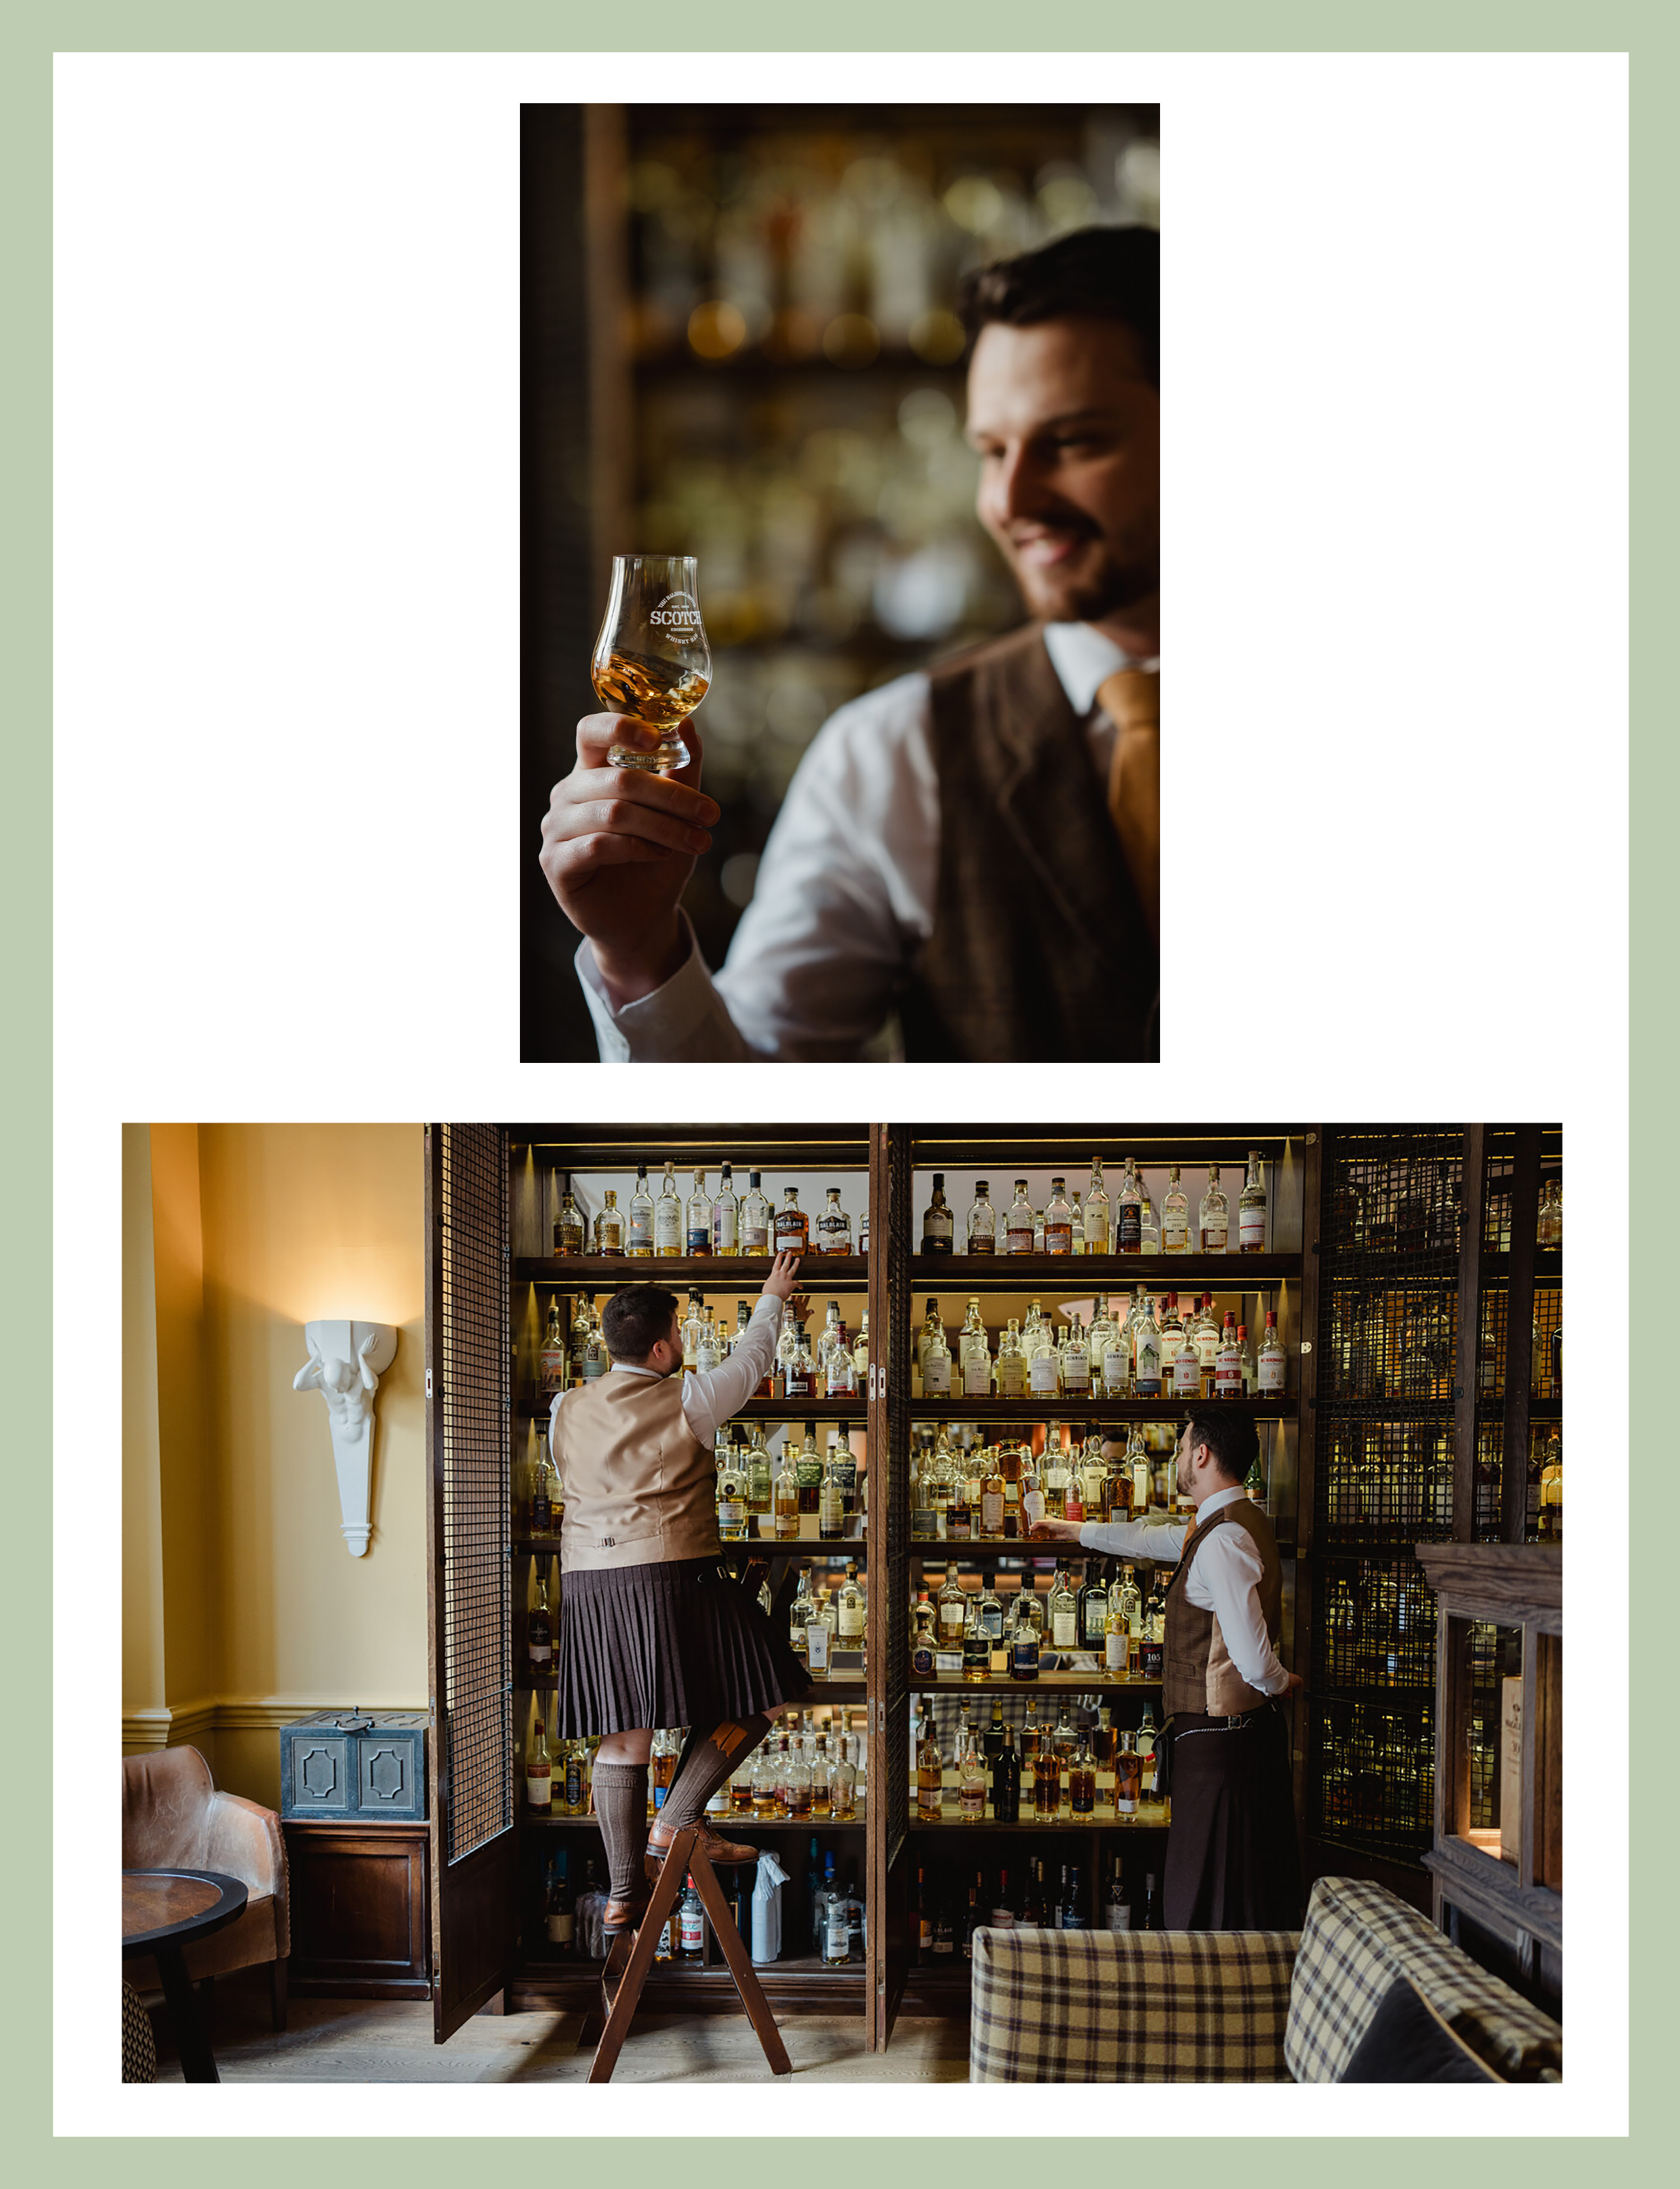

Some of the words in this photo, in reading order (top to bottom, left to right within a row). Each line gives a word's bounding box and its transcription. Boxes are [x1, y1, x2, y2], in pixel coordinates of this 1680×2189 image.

[650, 610, 703, 625] SCOTCH
[690, 633, 699, 643] BAR
[1147, 1653, 1161, 1662] 105
